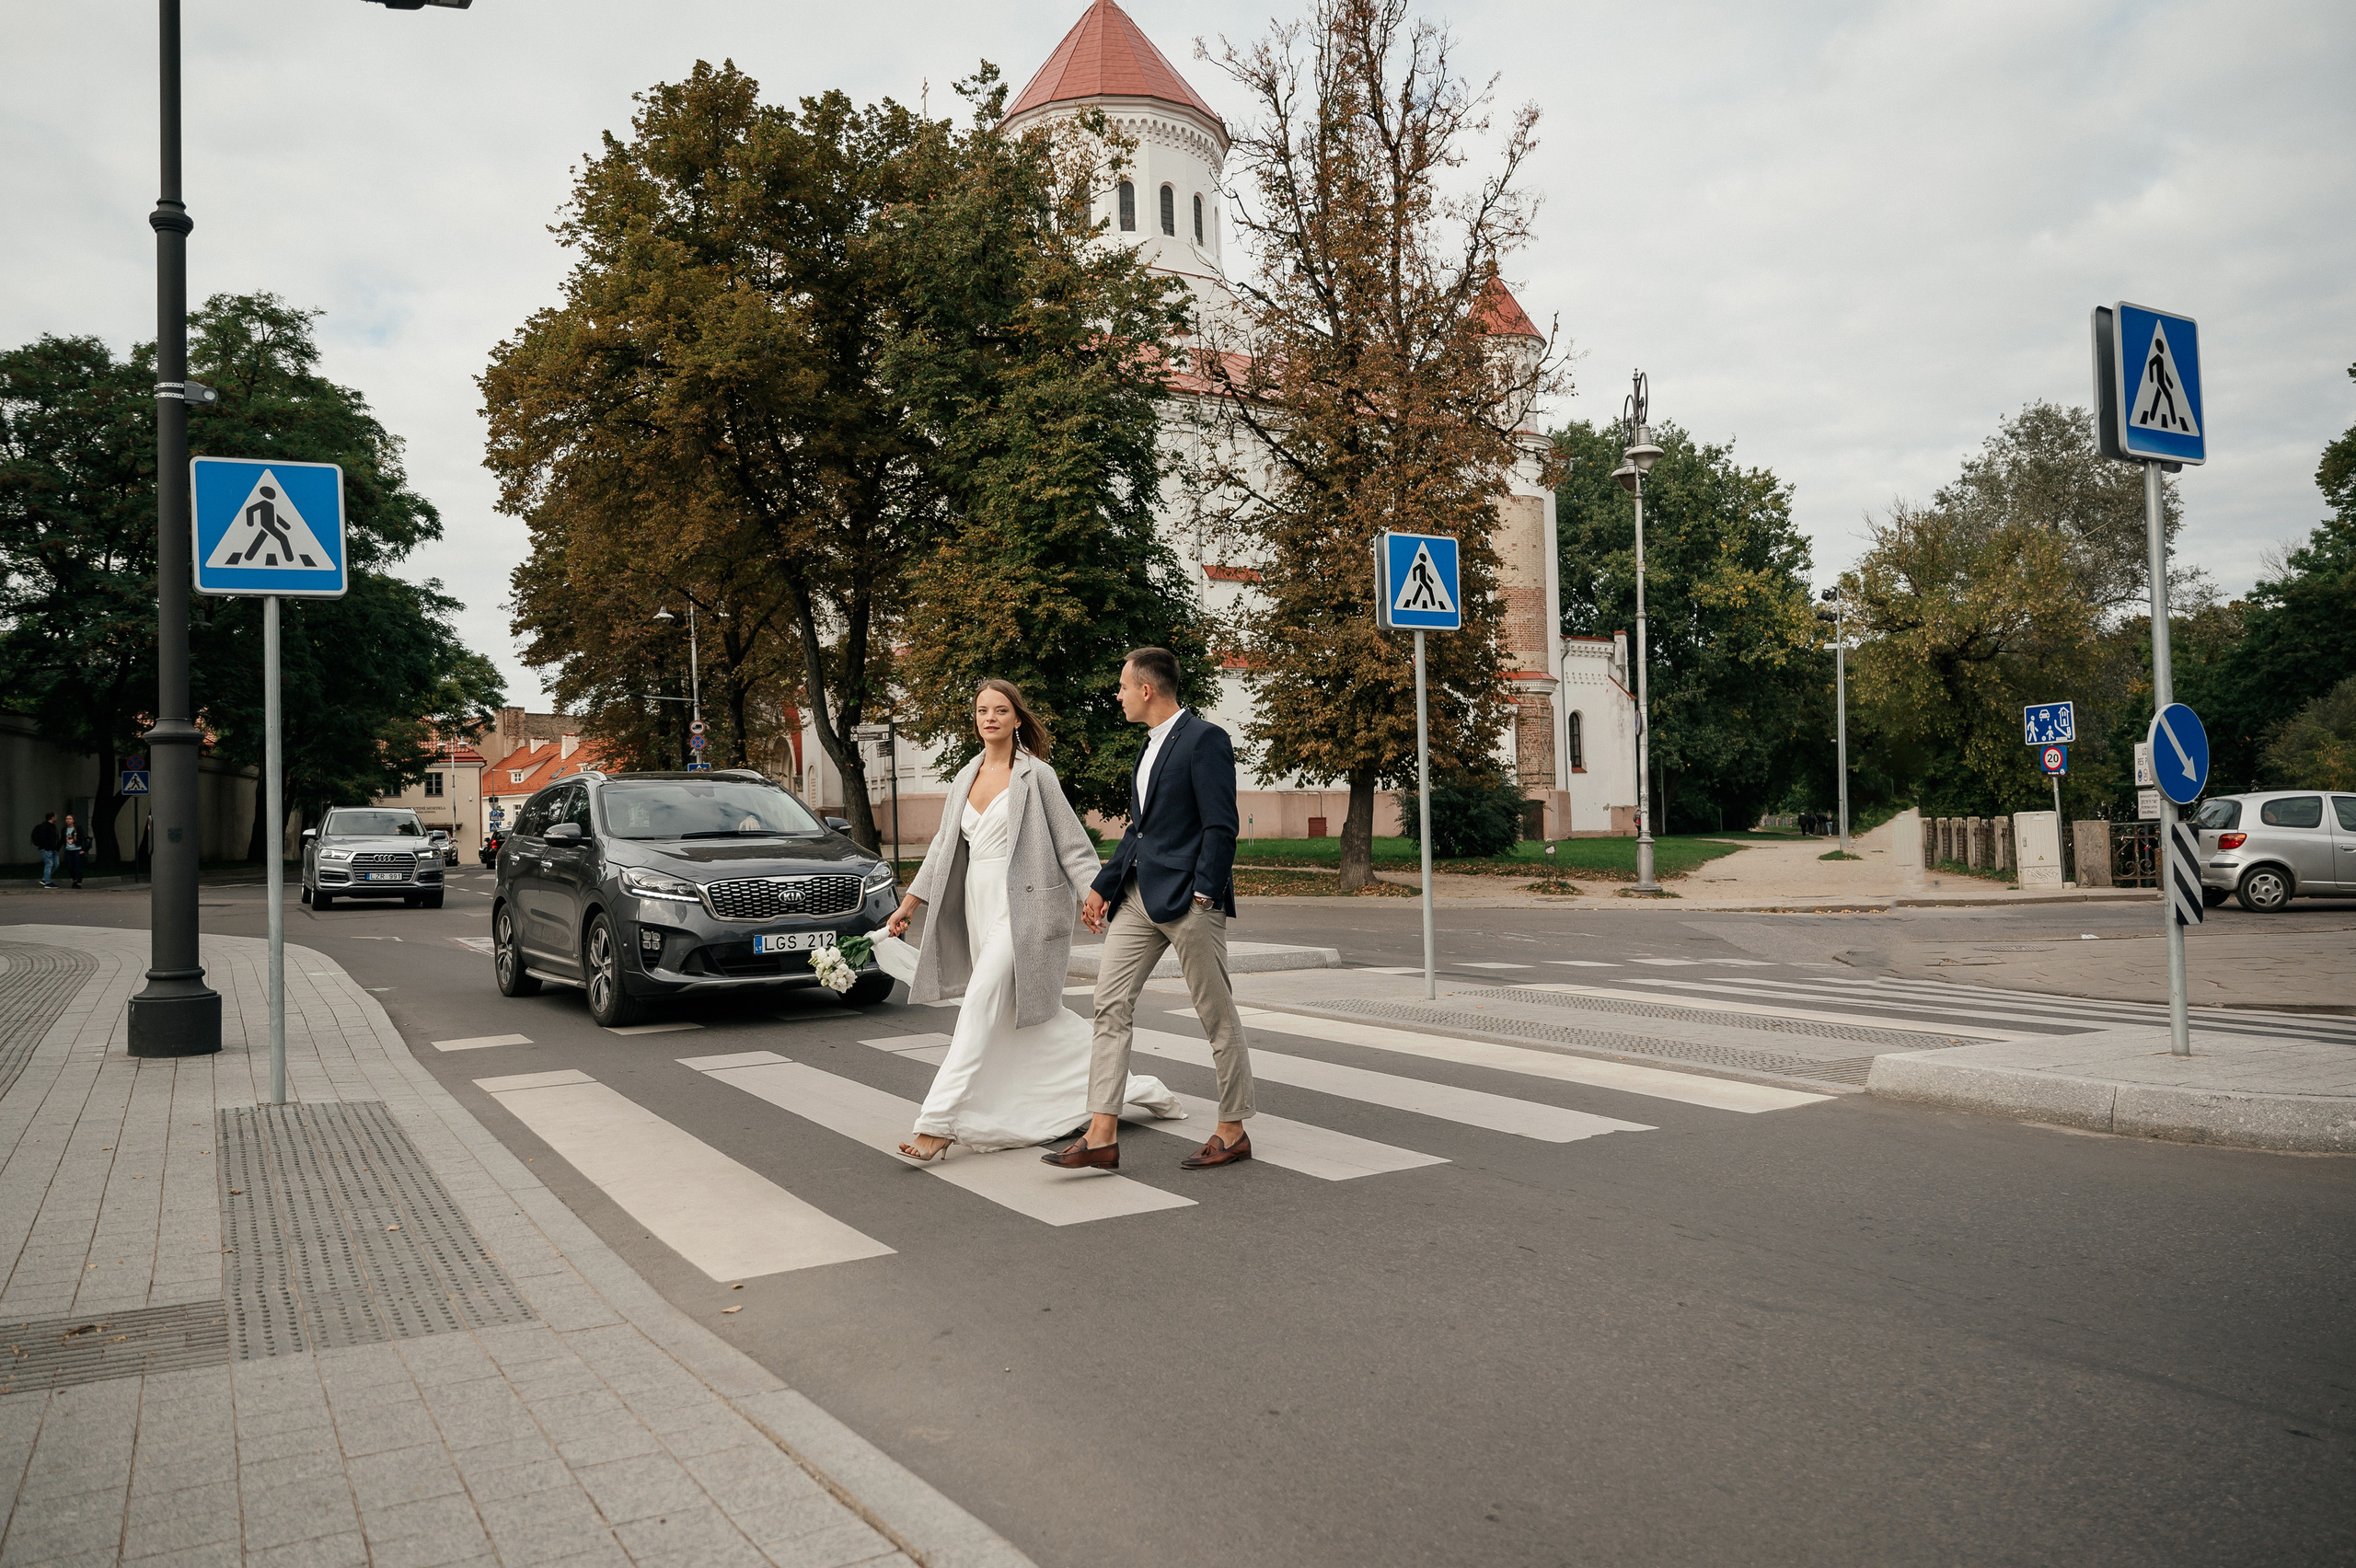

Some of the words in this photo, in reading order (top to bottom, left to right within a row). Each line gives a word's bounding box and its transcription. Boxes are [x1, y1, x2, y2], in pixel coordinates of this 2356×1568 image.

[2047, 754, 2059, 763] 20
[783, 892, 803, 901] KIA
[765, 935, 797, 951] LGS
[808, 933, 835, 948] 212
